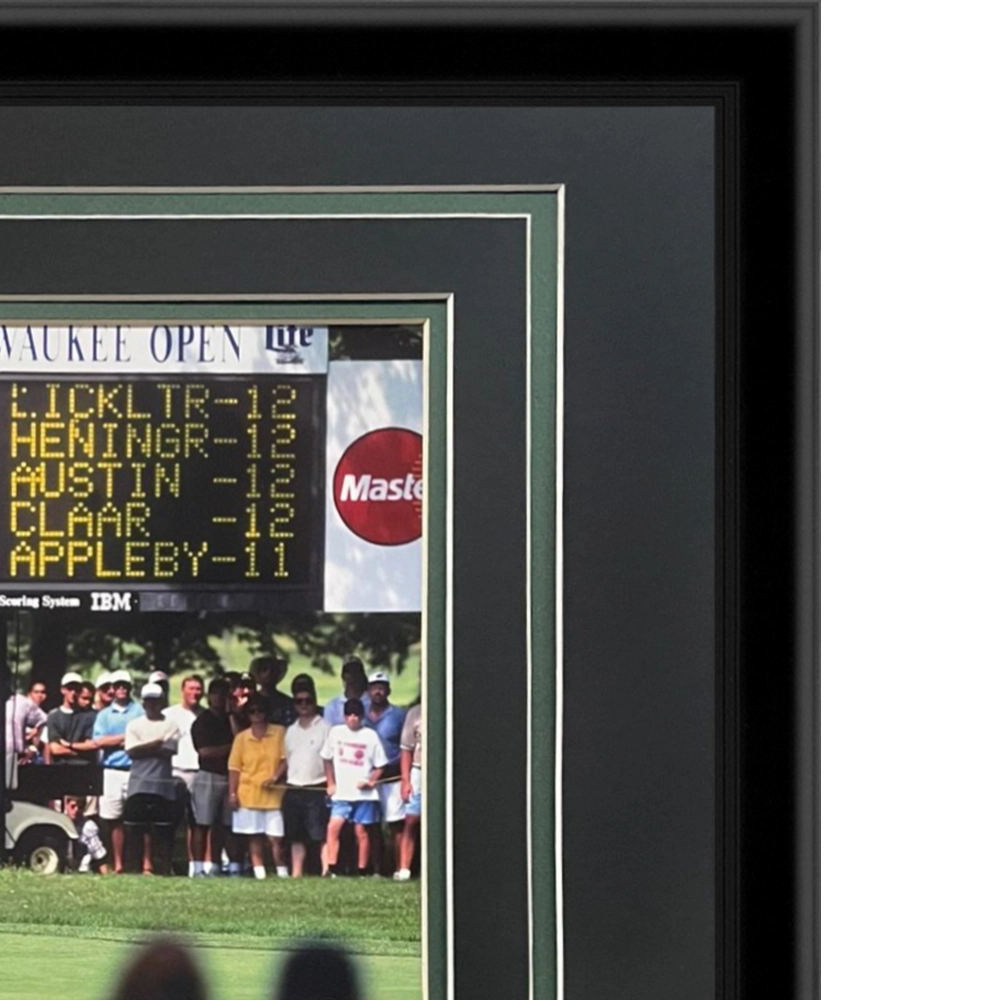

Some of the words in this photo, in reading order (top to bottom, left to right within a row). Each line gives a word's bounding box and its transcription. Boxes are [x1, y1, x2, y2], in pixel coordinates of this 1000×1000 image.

[149, 325, 241, 363] OPEN
[11, 461, 180, 498] AUSTIN
[11, 501, 150, 538] CLAAR
[42, 594, 81, 609] System
[90, 592, 132, 610] IBM
